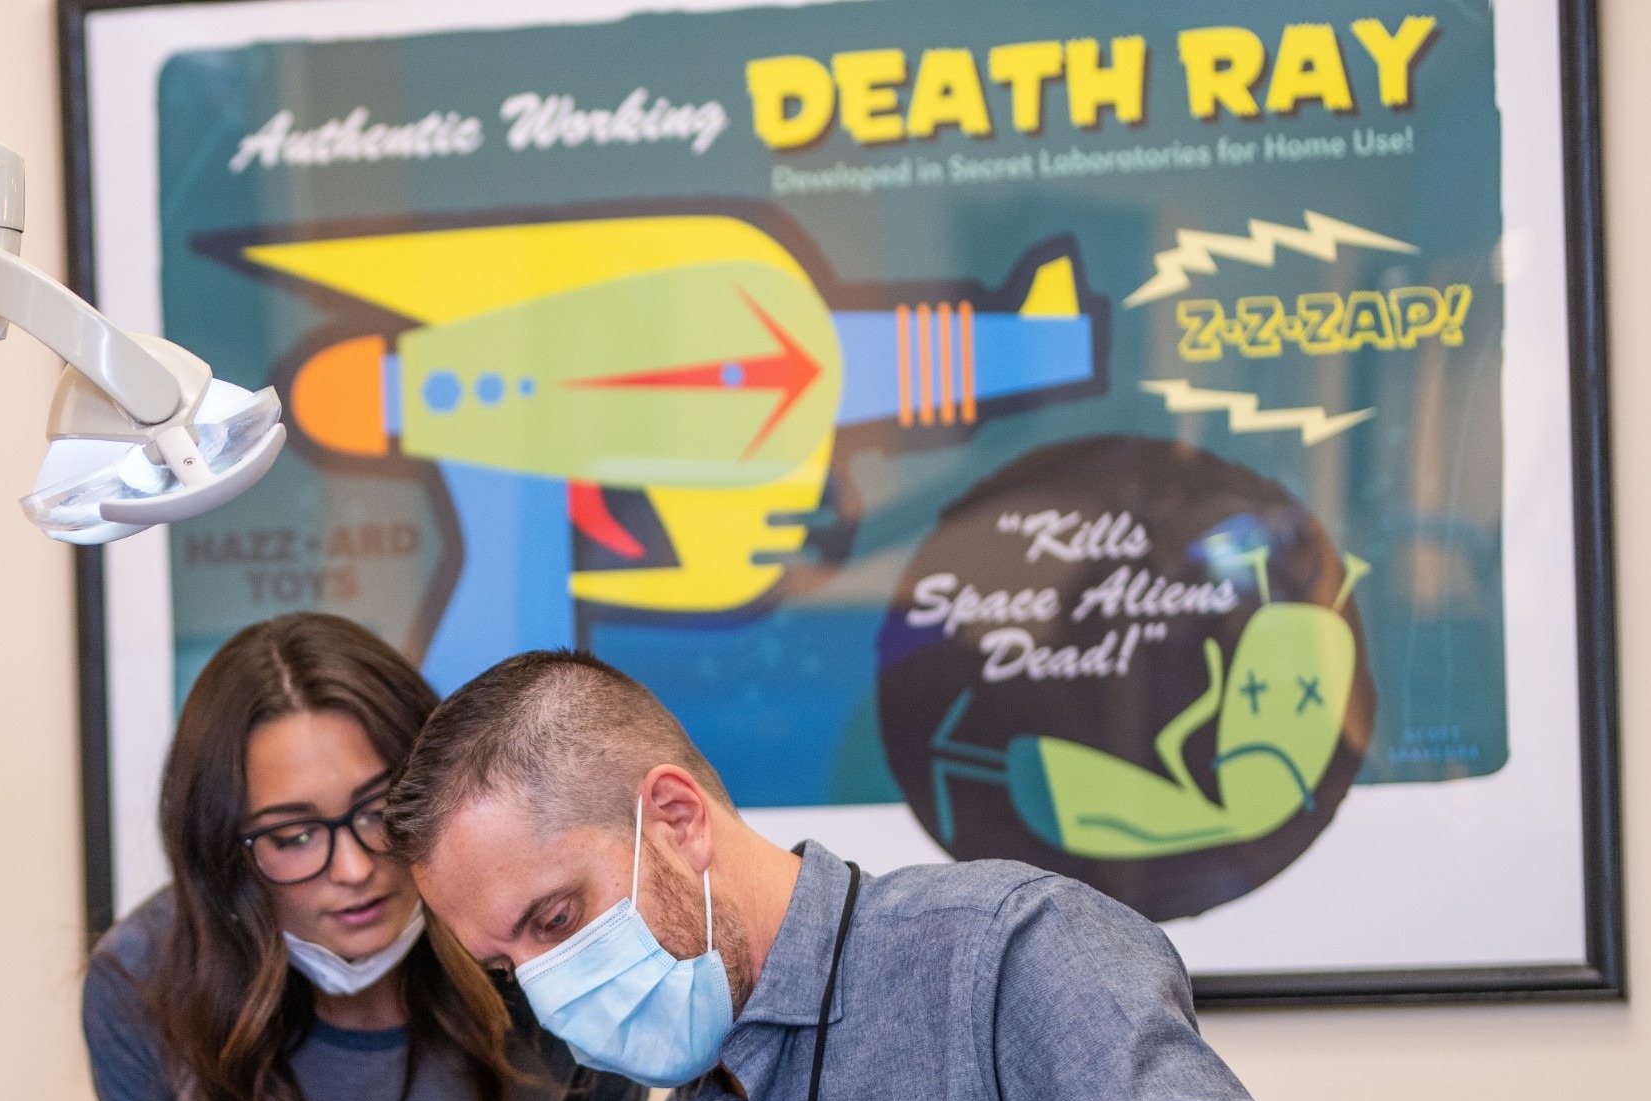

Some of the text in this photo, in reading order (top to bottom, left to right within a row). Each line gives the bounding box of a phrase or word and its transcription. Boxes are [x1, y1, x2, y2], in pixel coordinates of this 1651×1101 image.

[745, 15, 1437, 150] DEATH RAY
[230, 88, 727, 172] Authentic Working
[771, 124, 1414, 194] Developed in Secret Laboratories for Home Use!
[906, 564, 1240, 638] Space Aliens
